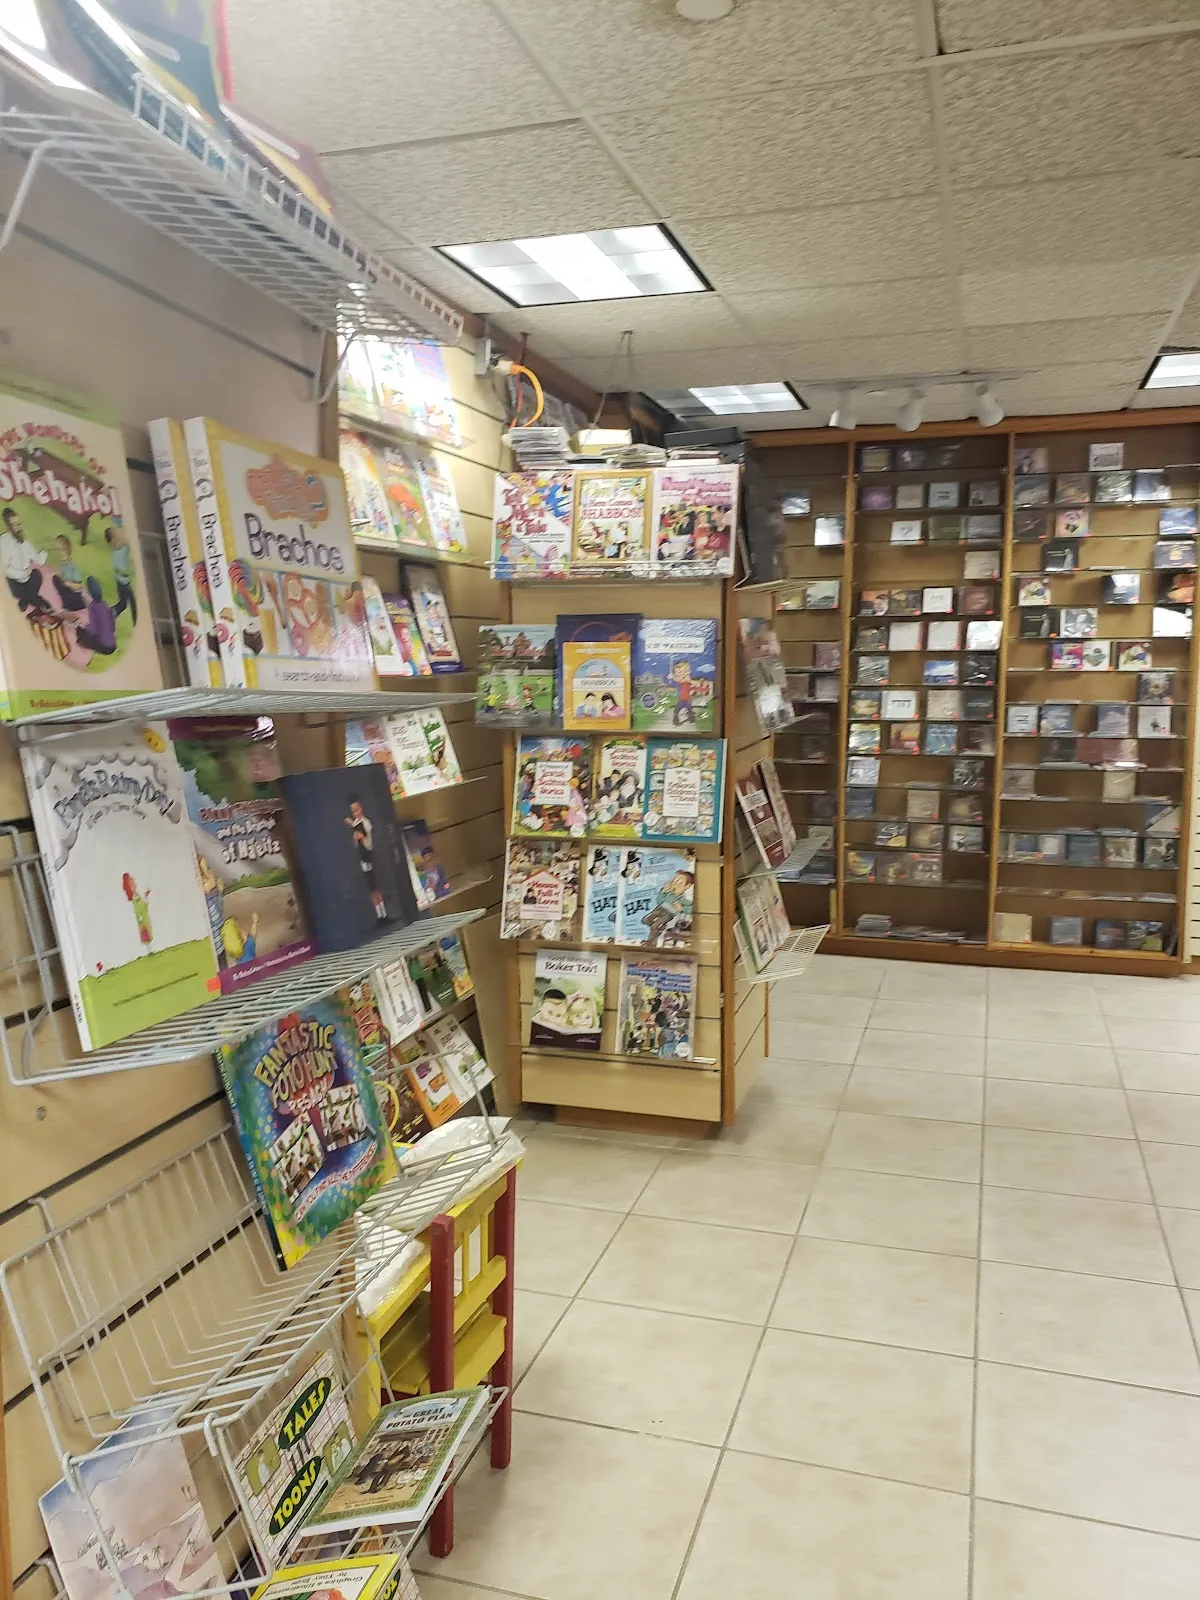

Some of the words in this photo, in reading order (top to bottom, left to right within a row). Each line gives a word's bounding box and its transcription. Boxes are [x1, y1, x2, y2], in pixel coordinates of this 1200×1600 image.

[243, 512, 345, 574] Brachos
[590, 896, 617, 914] HAT
[624, 898, 652, 917] HAT
[254, 1022, 335, 1088] FANTASTIC
[283, 1380, 325, 1443] TALES
[386, 1416, 424, 1429] POTATO
[427, 1412, 454, 1422] PLAN
[413, 1407, 445, 1418] GREAT
[274, 1460, 316, 1529] TOONS
[325, 1576, 363, 1585] Graphics
